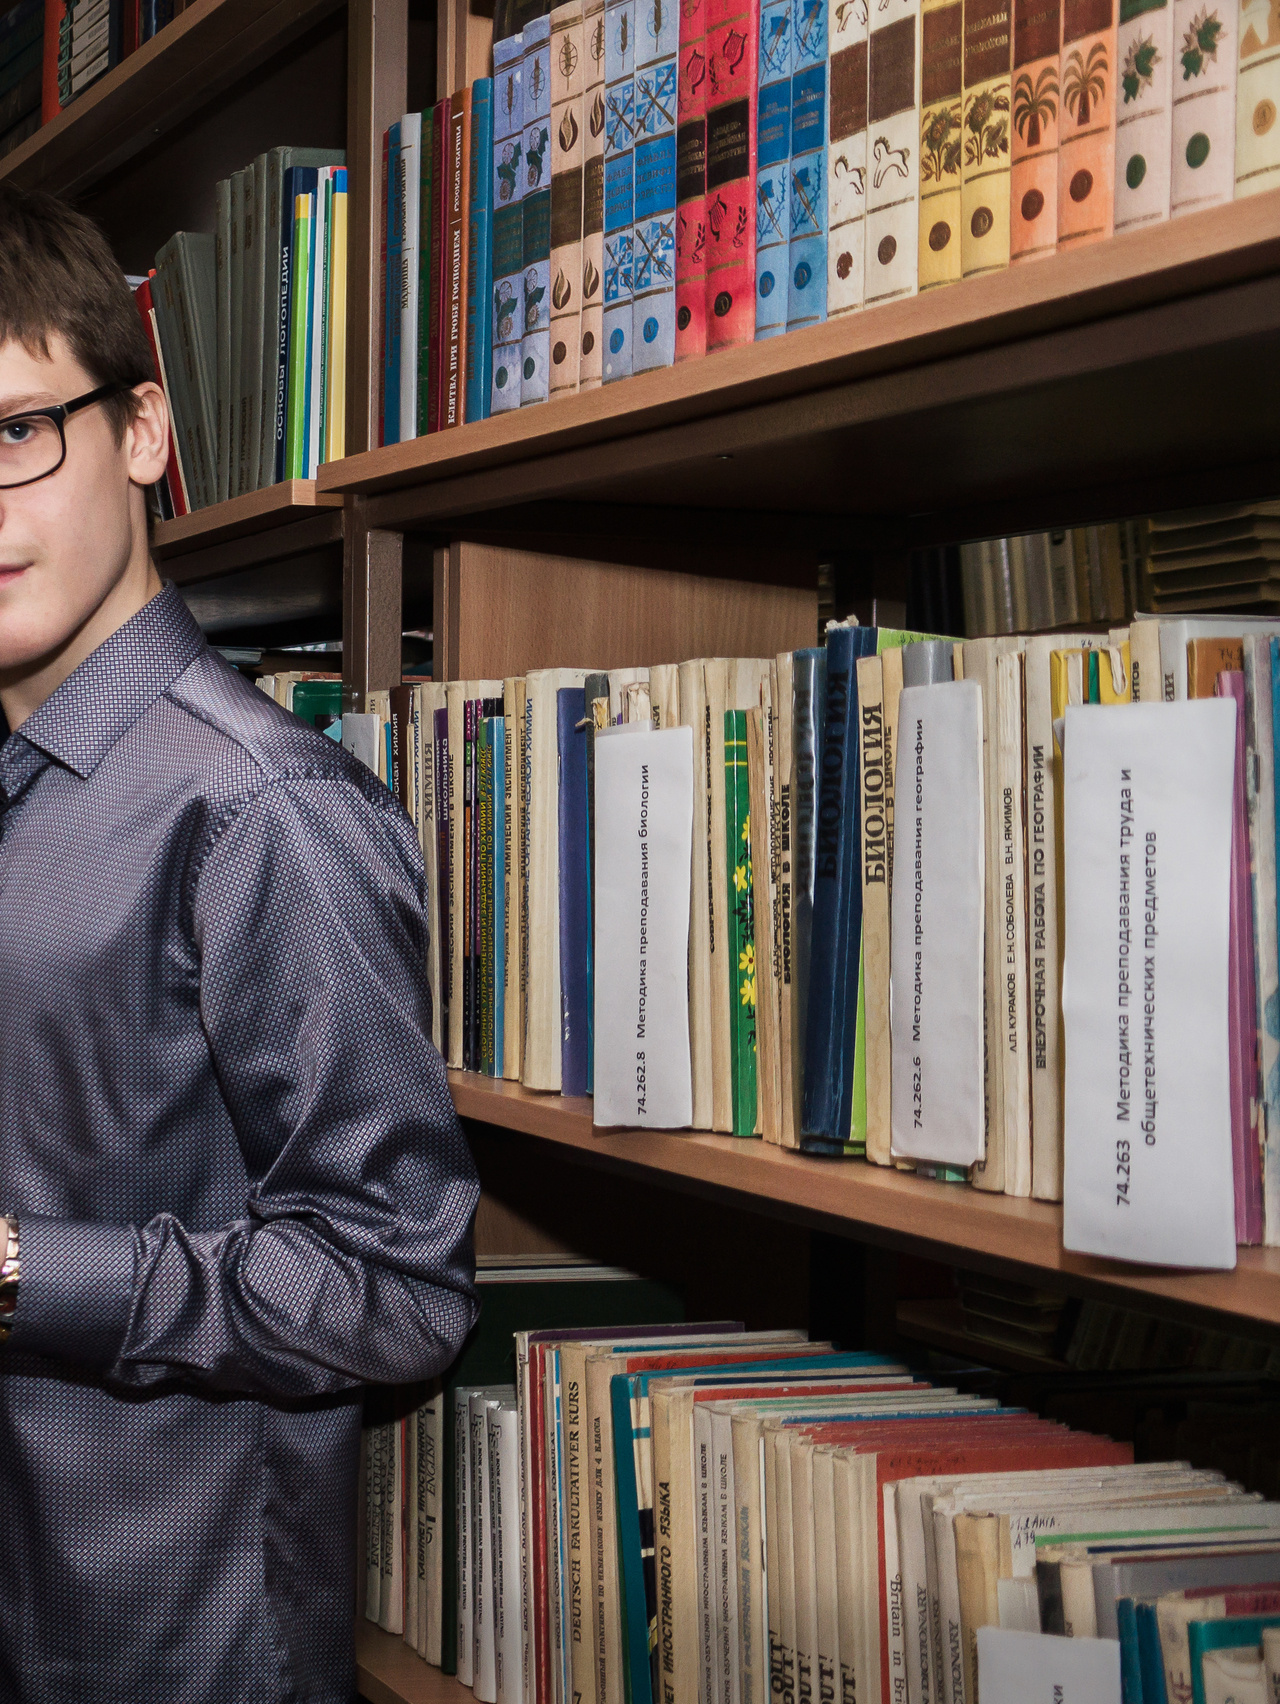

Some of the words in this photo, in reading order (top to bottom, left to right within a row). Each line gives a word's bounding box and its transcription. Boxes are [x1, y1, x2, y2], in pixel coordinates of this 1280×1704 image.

[452, 229, 462, 300] ГОСПОДНЕМ
[280, 245, 290, 355] ЛОГОПЕДИИ
[451, 303, 460, 340] ГРОБЕ
[450, 344, 459, 371] ПРИ
[277, 364, 286, 441] ОСНОВЫ
[447, 374, 458, 425] КЛЯТВА
[424, 741, 434, 821] ХИМИЯ
[504, 728, 512, 799] ЭКСПЕРИМЕНТ
[817, 669, 849, 880] БИОЛОГИЯ
[884, 725, 894, 788] ШКОЛЕ
[914, 719, 924, 811] географии
[1121, 768, 1132, 781] и
[638, 764, 650, 838] биологии
[781, 784, 790, 851] ШКОЛЕ
[862, 702, 886, 886] БИОЛОГИЯ
[1003, 787, 1012, 841] ЯКИМОВ
[1033, 745, 1045, 843] ГЕОГРАФИИ
[1119, 788, 1134, 847] труда
[480, 844, 487, 857] ПО
[487, 836, 493, 851] ПО
[1004, 843, 1013, 865] В.Н.
[1034, 848, 1045, 876] ПО
[638, 842, 650, 954] преподавания
[914, 817, 924, 946] преподавания
[1005, 873, 1015, 940] СОБОЛЕВА
[1143, 831, 1158, 949] предметов
[782, 883, 791, 984] БИОЛОГИЯ
[1034, 882, 1046, 950] РАБОТА
[1118, 854, 1133, 1007] преподавания
[1006, 942, 1015, 964] Е.Н.
[636, 959, 648, 1038] Методика
[912, 951, 923, 1042] Методика
[1007, 972, 1017, 1030] КУРАКОВ
[1035, 957, 1046, 1070] ВНЕУРОЧНАЯ
[636, 1051, 647, 1115] 74.262.8
[1116, 1014, 1132, 1122] Методика
[1141, 955, 1159, 1146] общетехнических
[912, 1056, 923, 1129] 74.262.6
[1116, 1139, 1131, 1207] 74.263
[568, 1380, 579, 1426] KURS
[593, 1416, 602, 1453] КЛАССА
[417, 1409, 426, 1512] ИНОСТРАННОГО
[425, 1434, 436, 1497] ENGLISH
[550, 1431, 558, 1490] FORMULAS
[569, 1430, 581, 1551] FAKULTATIVER
[700, 1443, 708, 1479] ШКОЛЕ
[719, 1453, 727, 1490] ШКОЛЕ
[371, 1503, 380, 1568] ENGLISH
[658, 1481, 671, 1539] ЯЗЫКА
[701, 1492, 709, 1535] ЯЗЫКАМ
[720, 1503, 728, 1546] ЯЗЫКАМ
[417, 1517, 426, 1581] КАБИНЕТ
[551, 1498, 560, 1598] CONVERSATIONAL
[702, 1537, 710, 1610] ИНОСТРАННЫМ
[552, 1600, 561, 1650] ENGLISH
[571, 1559, 582, 1644] DEUTSCH
[660, 1545, 674, 1674] ИНОСТРАННОГО
[889, 1573, 904, 1637] Britain
[723, 1626, 731, 1676] ОБУЧЕНИЯ
[768, 1629, 783, 1695] OUT!
[892, 1650, 905, 1667] in
[916, 1582, 929, 1692] DICTIONARY
[818, 1653, 834, 1704] UT!
